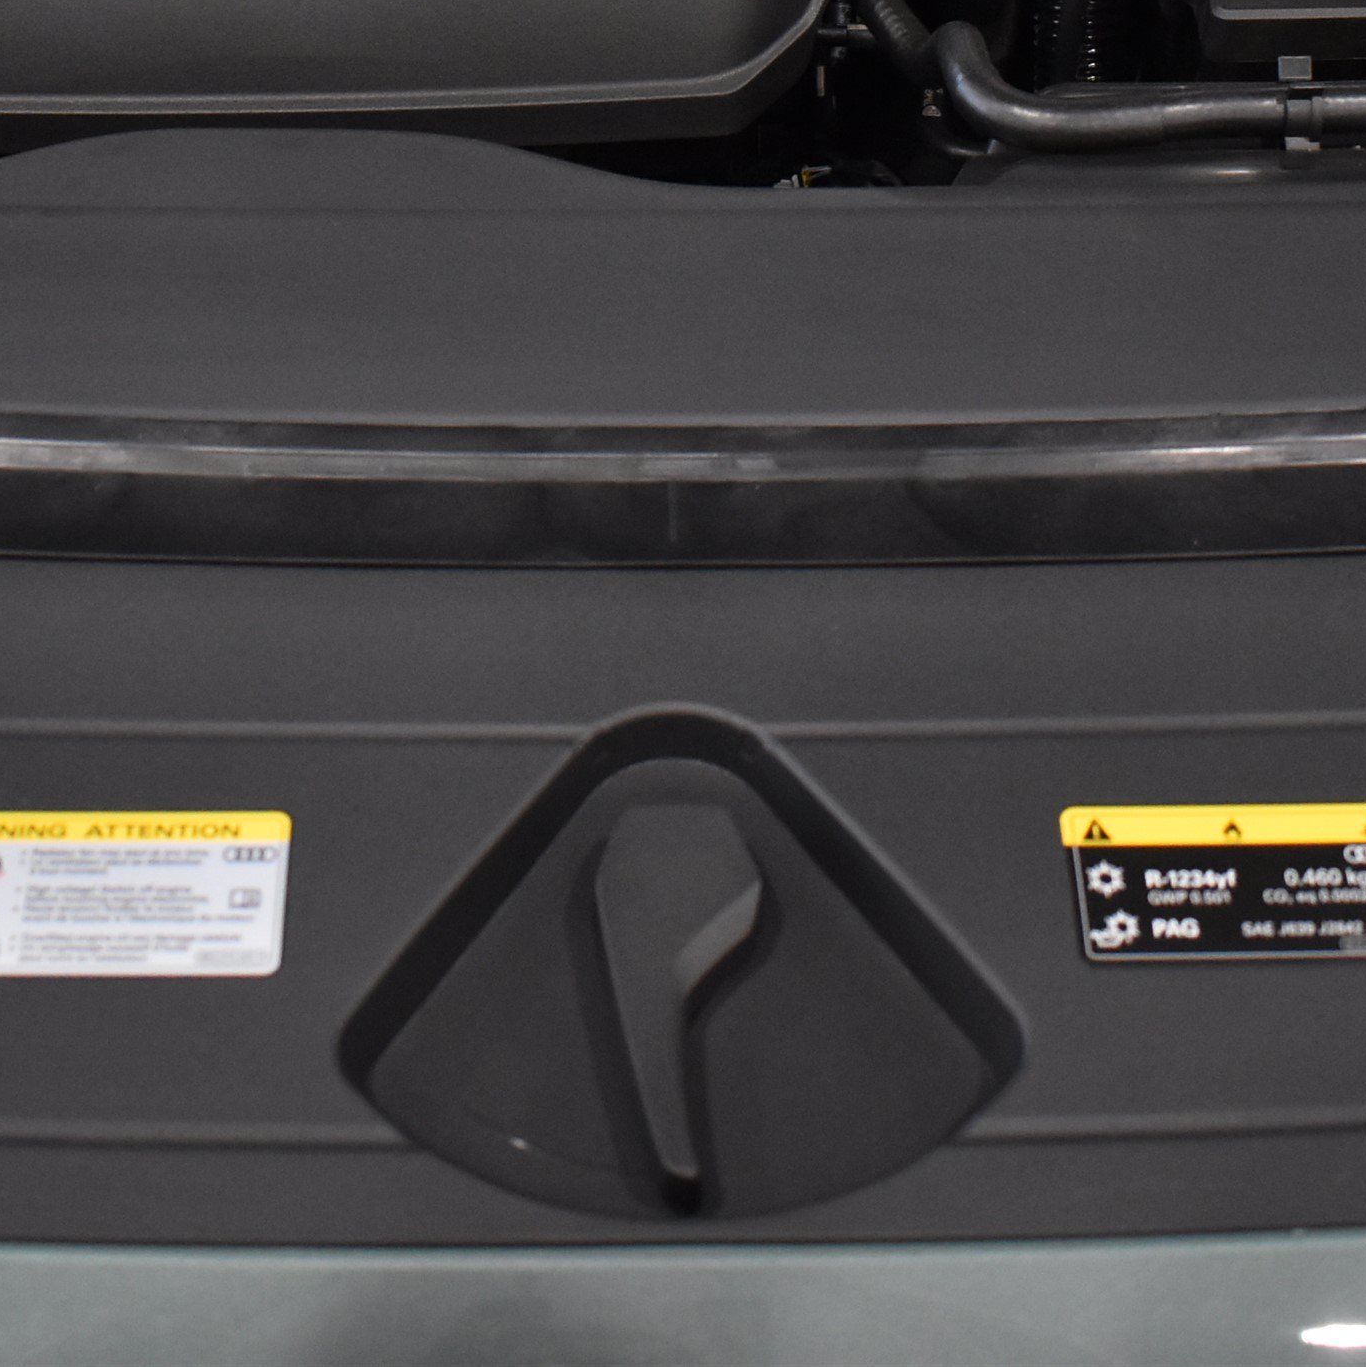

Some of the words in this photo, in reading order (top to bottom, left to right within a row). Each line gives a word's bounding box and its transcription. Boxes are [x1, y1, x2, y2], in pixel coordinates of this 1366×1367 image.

[85, 823, 242, 839] ATTENTION
[1145, 868, 1237, 889] R-1234yf
[1152, 917, 1201, 939] PAG
[1241, 920, 1276, 939] SAE
